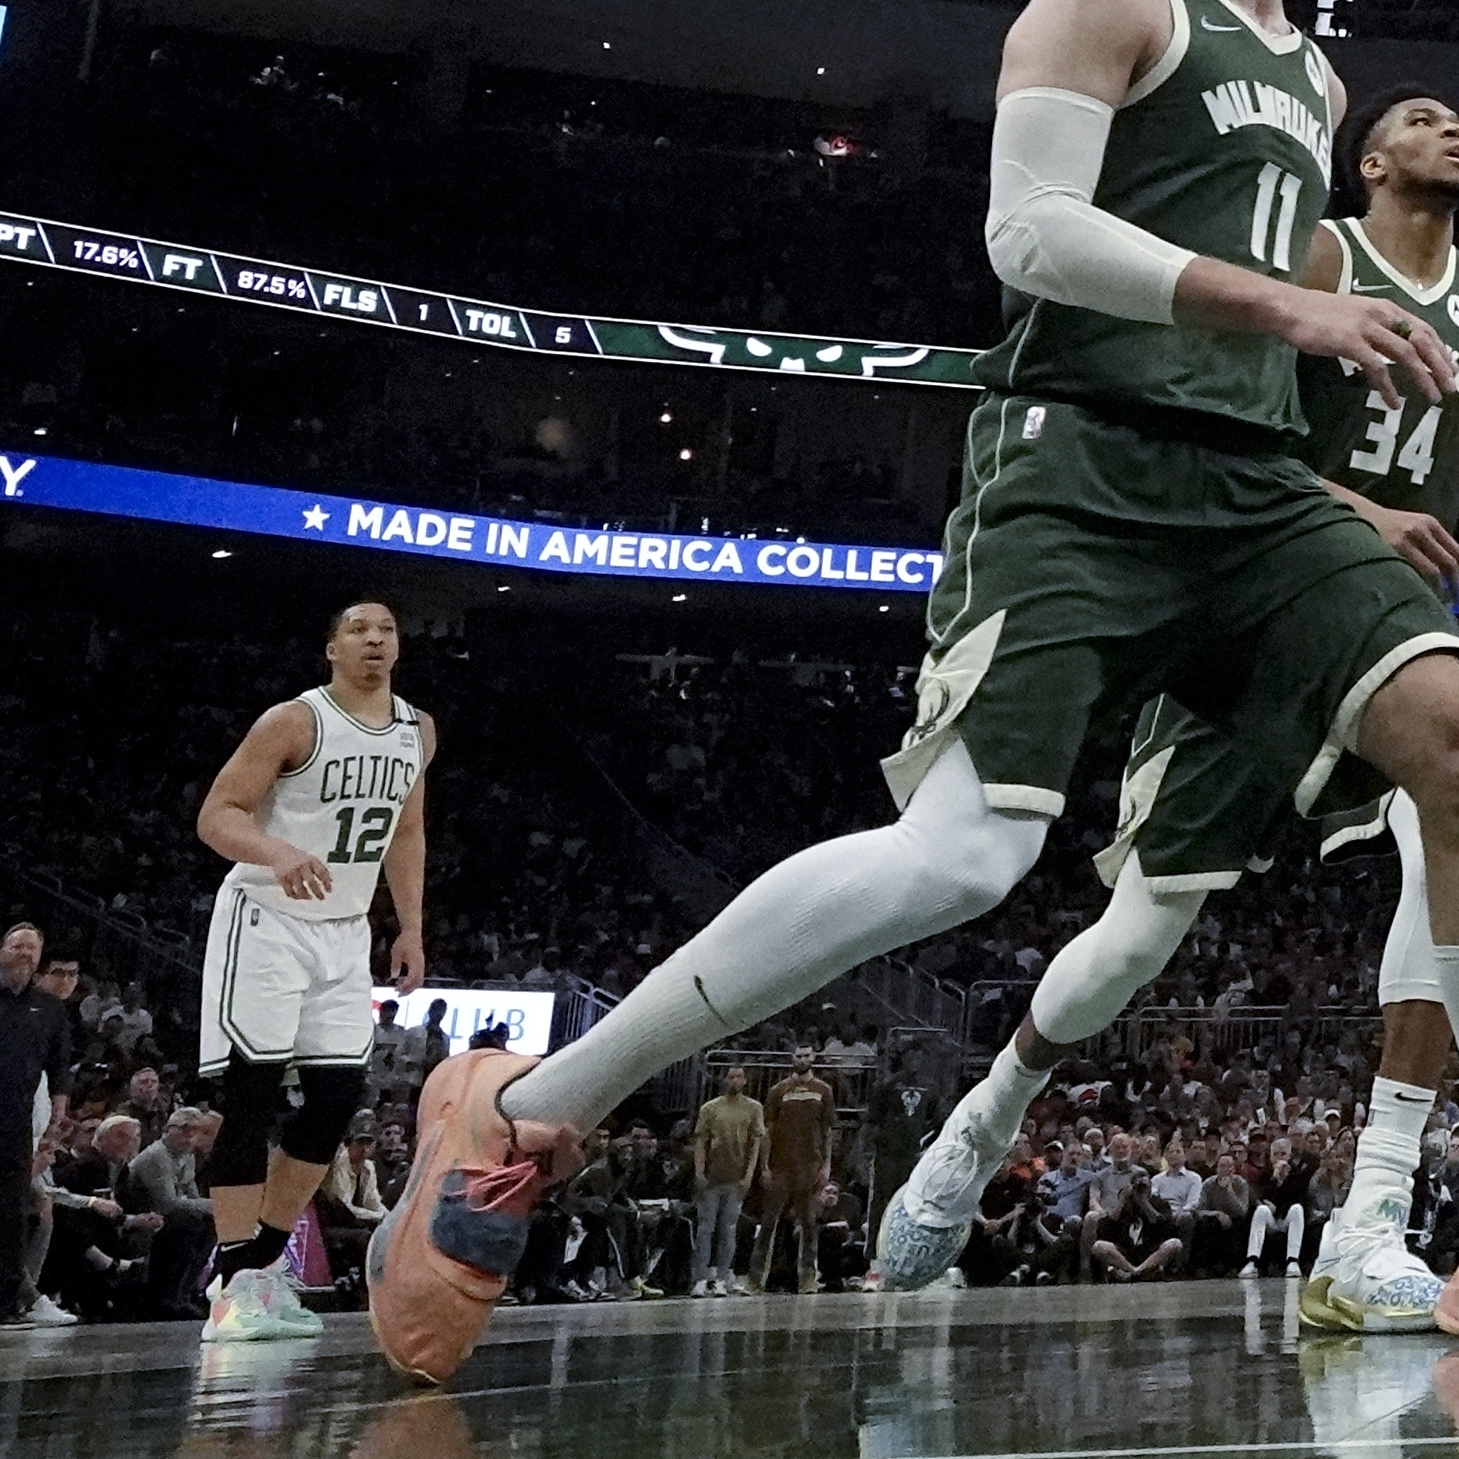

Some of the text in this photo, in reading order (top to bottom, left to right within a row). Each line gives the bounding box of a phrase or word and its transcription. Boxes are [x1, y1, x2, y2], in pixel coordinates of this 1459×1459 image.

[1250, 161, 1303, 272] 11
[73, 239, 572, 344] 17.6% FT 87.5% FLS 1 TOL 5
[1349, 390, 1444, 486] 34
[347, 503, 475, 552] MADE
[486, 522, 535, 559] IN
[538, 530, 743, 574] AMERICA
[320, 755, 415, 806] CELTICS
[326, 807, 394, 864] 12
